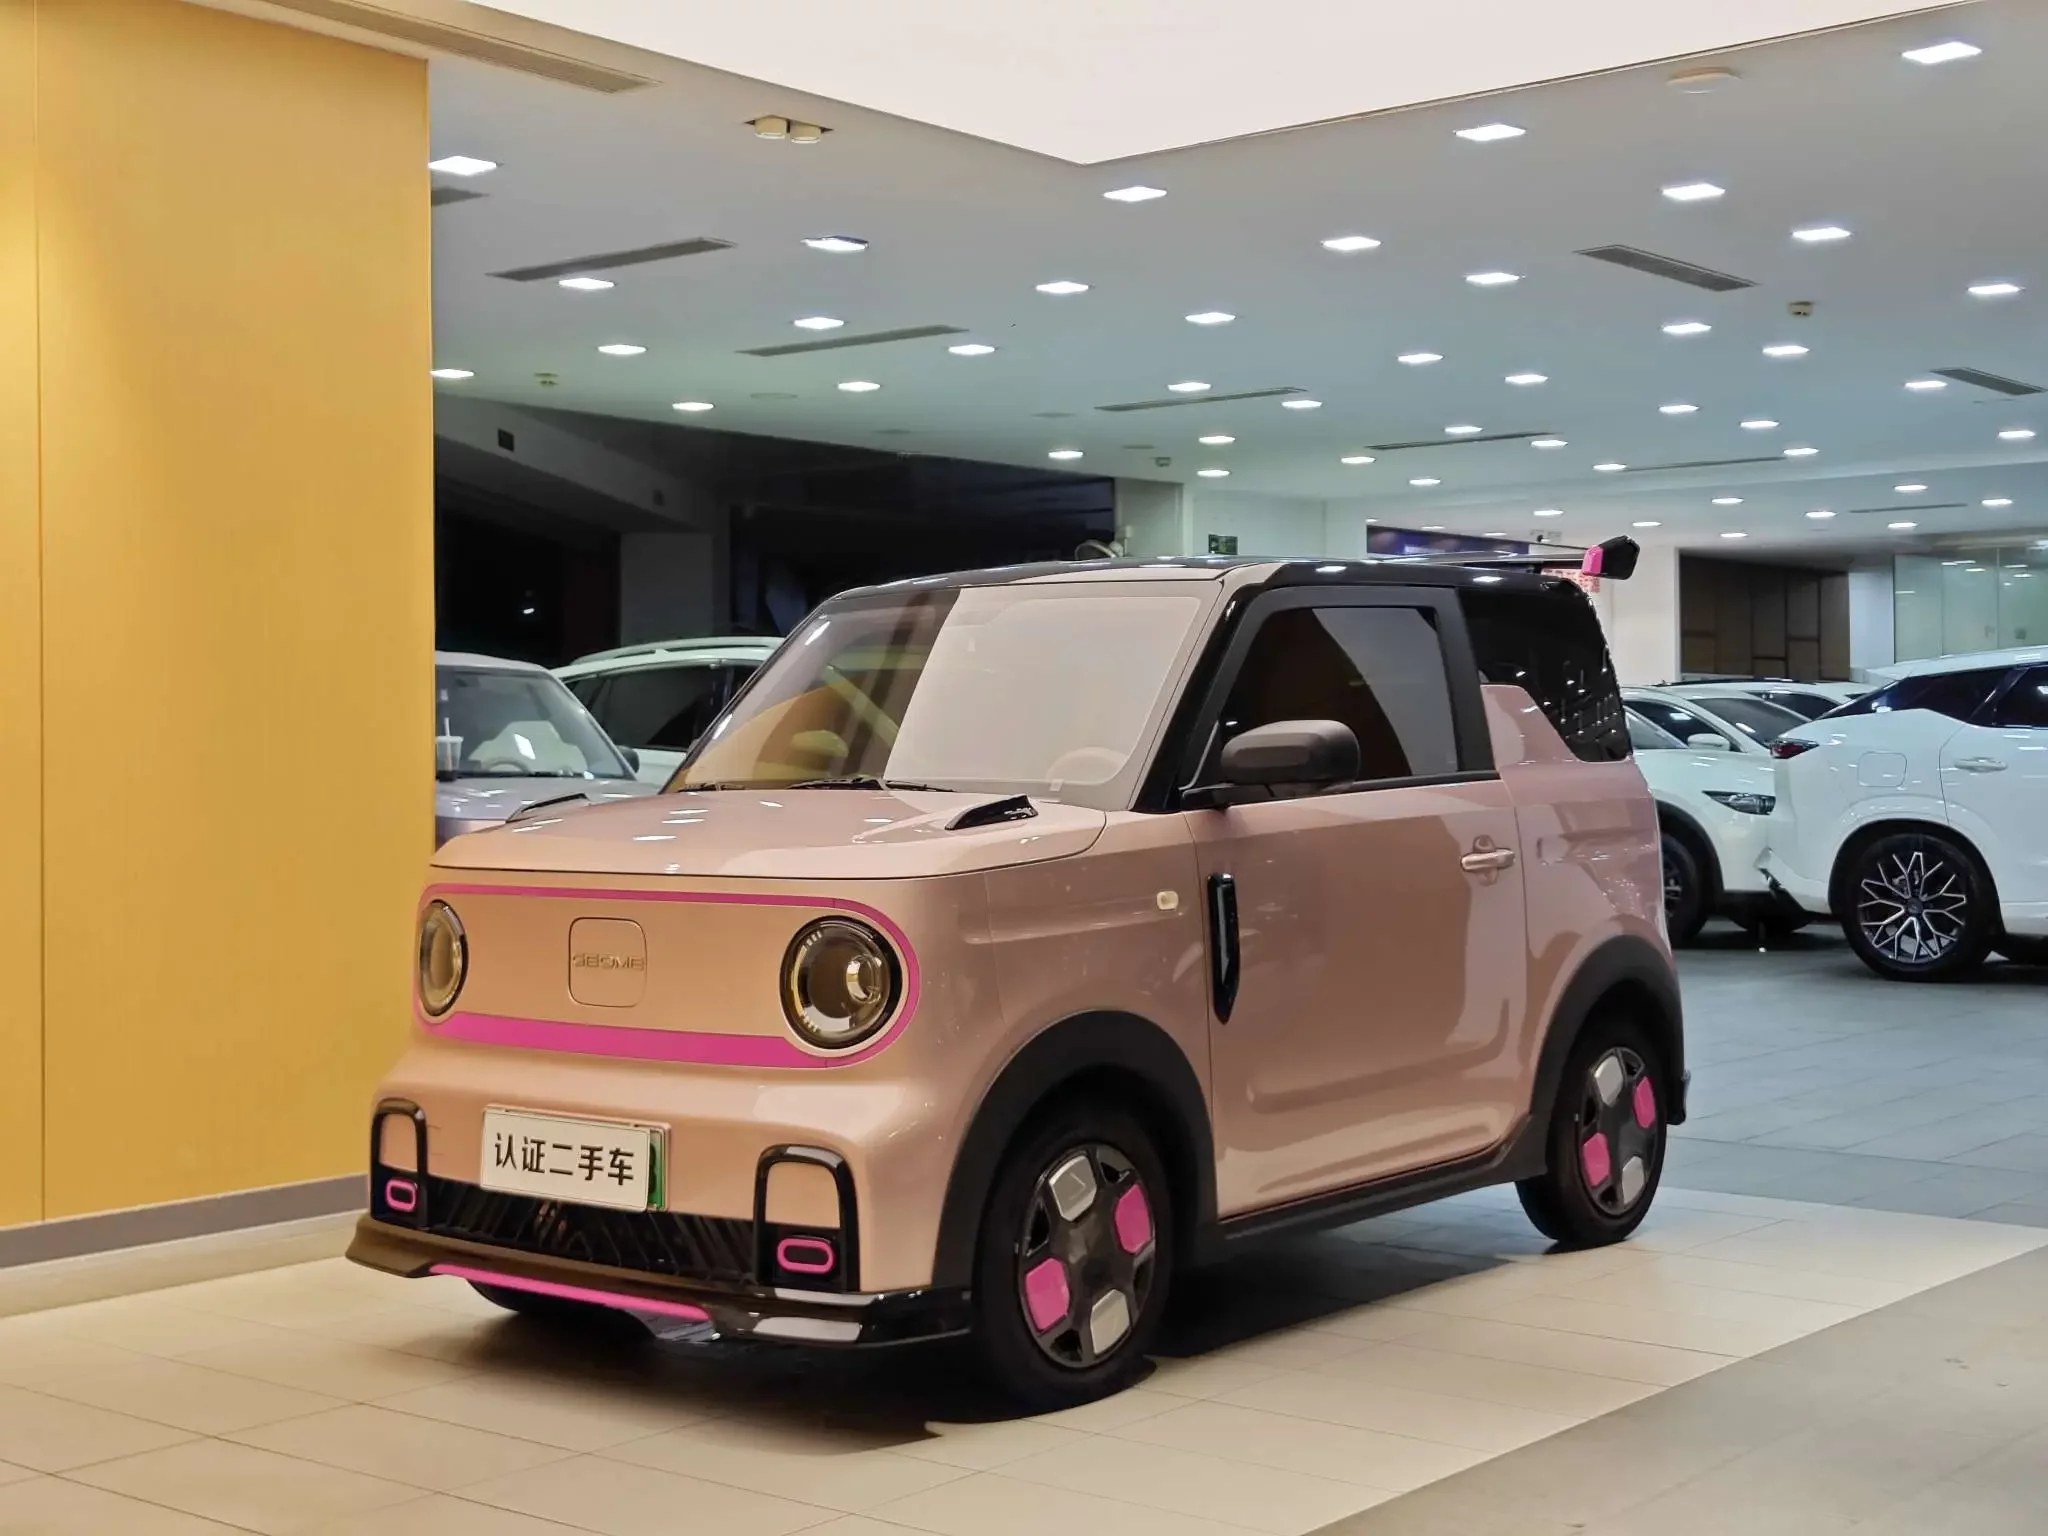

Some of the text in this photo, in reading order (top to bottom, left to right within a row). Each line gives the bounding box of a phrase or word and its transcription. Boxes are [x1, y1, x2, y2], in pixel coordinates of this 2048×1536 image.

[494, 1132, 635, 1186] 认证二手车
